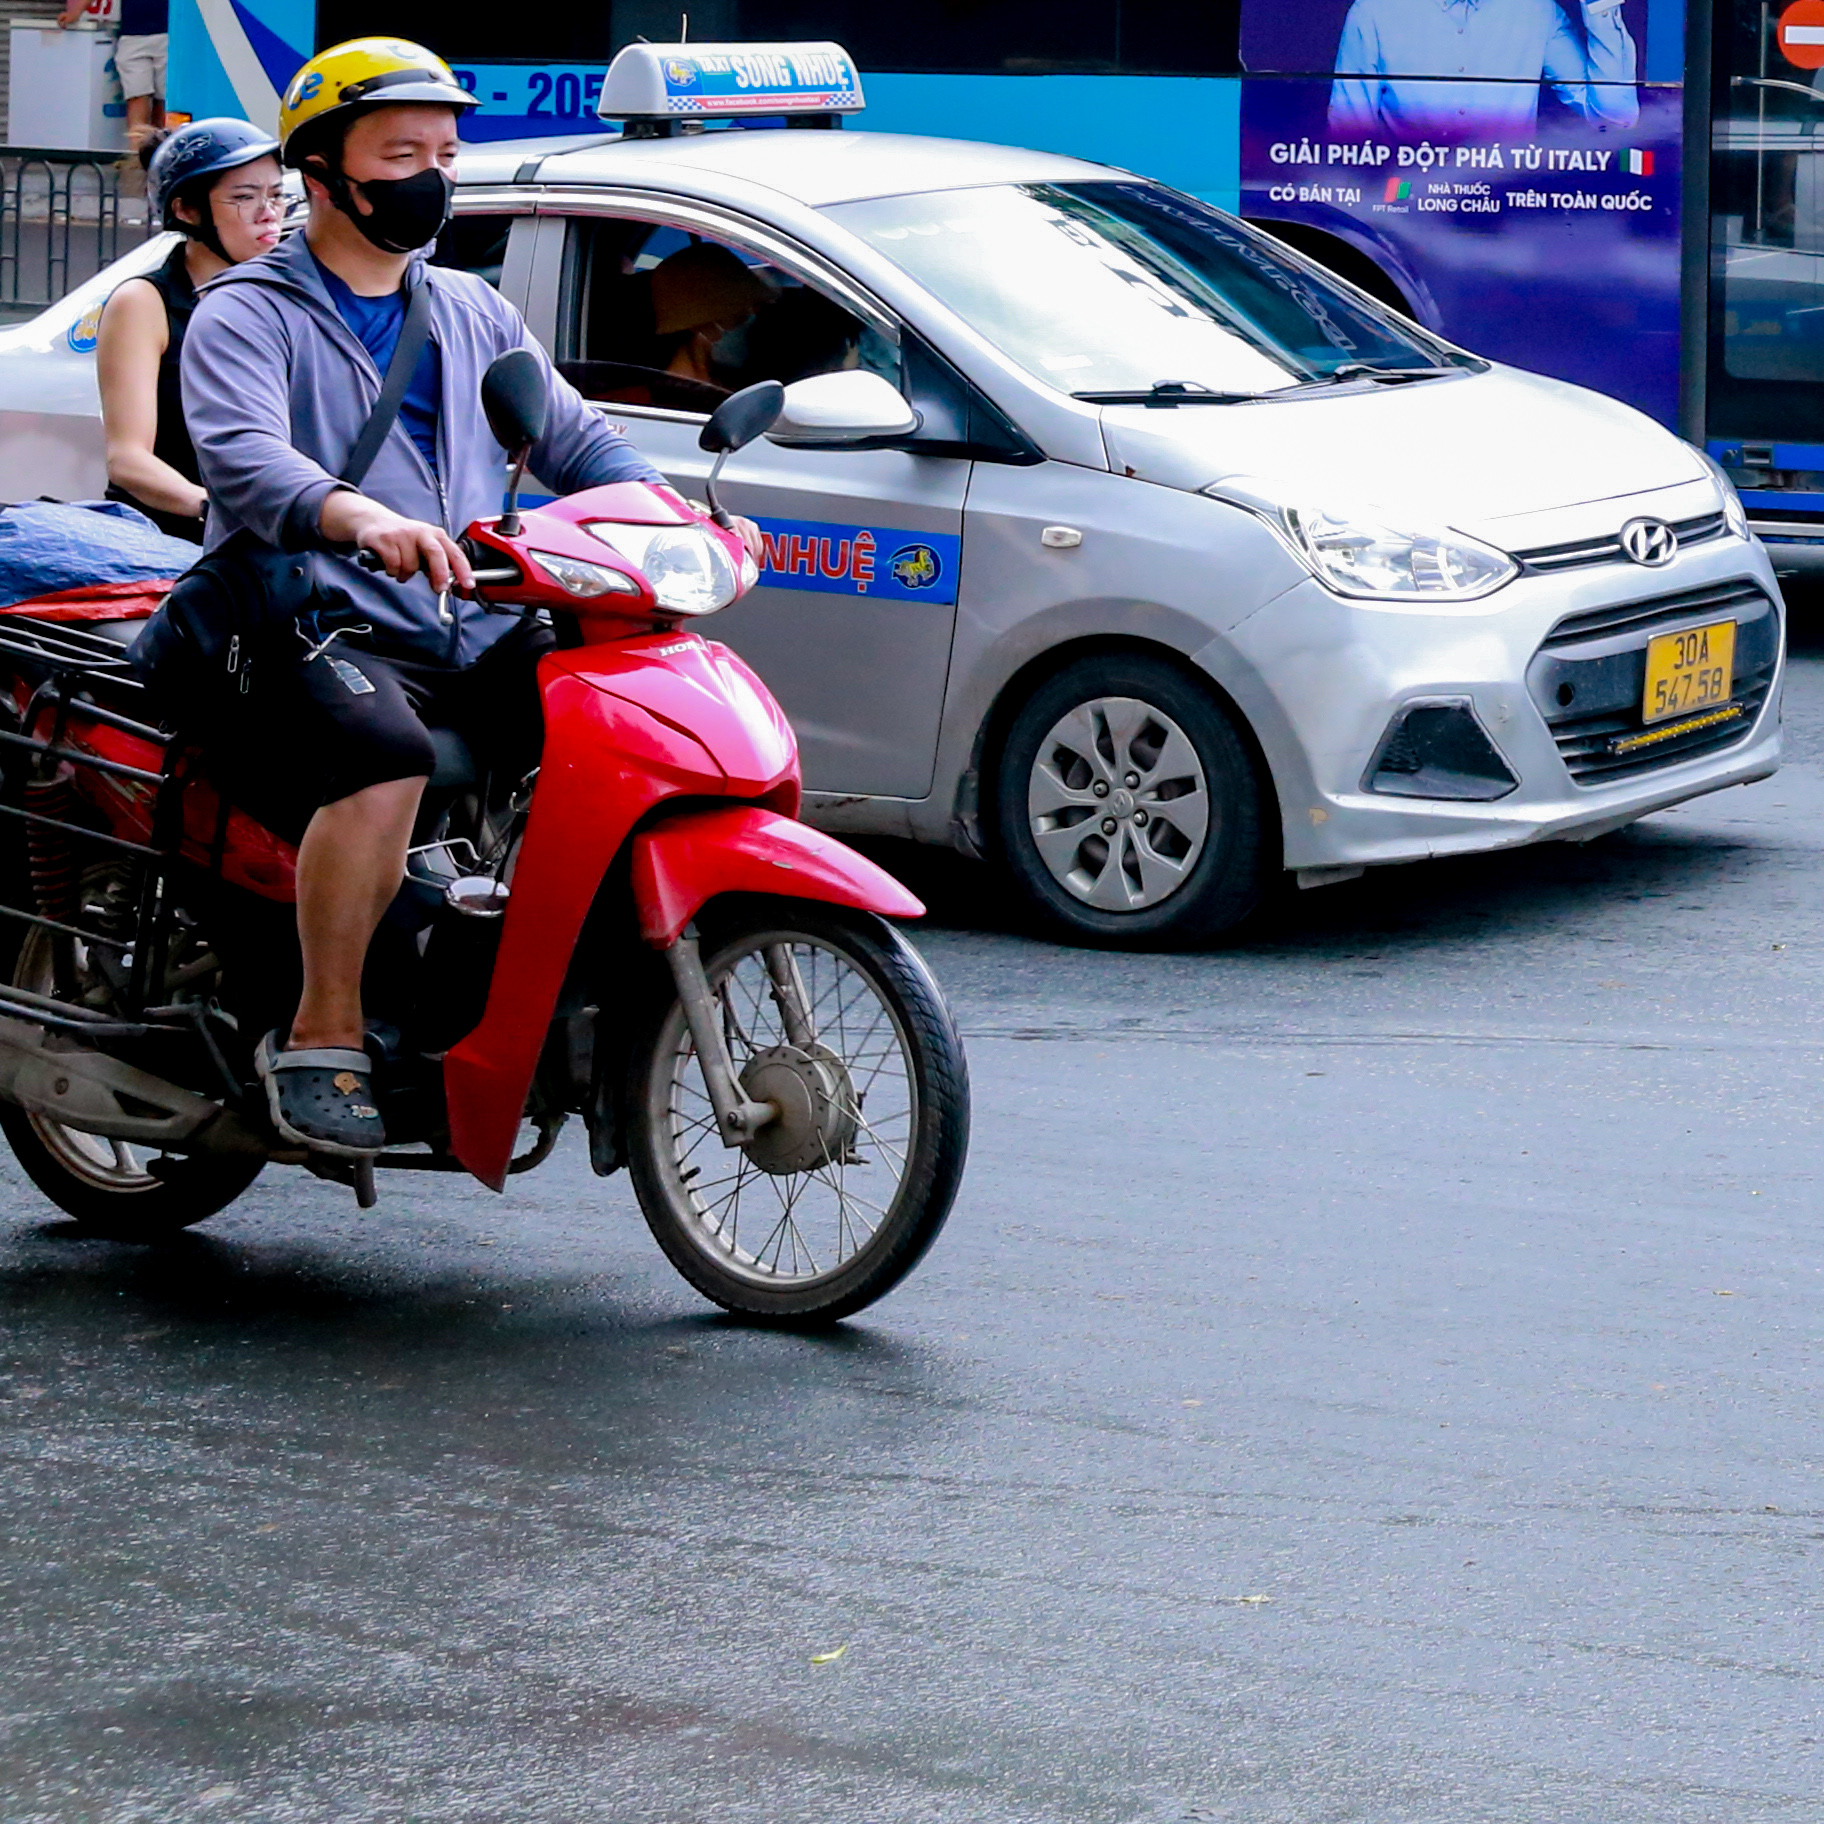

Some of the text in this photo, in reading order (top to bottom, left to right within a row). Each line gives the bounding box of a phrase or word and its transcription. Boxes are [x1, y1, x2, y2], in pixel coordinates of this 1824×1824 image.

[700, 54, 732, 73] TAXI
[1269, 138, 1612, 173] GIẢI PHÁP ĐỘT PHÁ TỪ ITALY
[1270, 182, 1361, 205] CÓ BÁN TẠI
[1428, 182, 1492, 196] NHÀ THUỐC
[1506, 188, 1654, 211] TRÊN TOÀN QUỐC
[1417, 195, 1501, 214] LONG CHÂU
[758, 530, 877, 593] NHUỆ
[1673, 630, 1709, 670] 30A
[1655, 667, 1724, 714] 547.58
